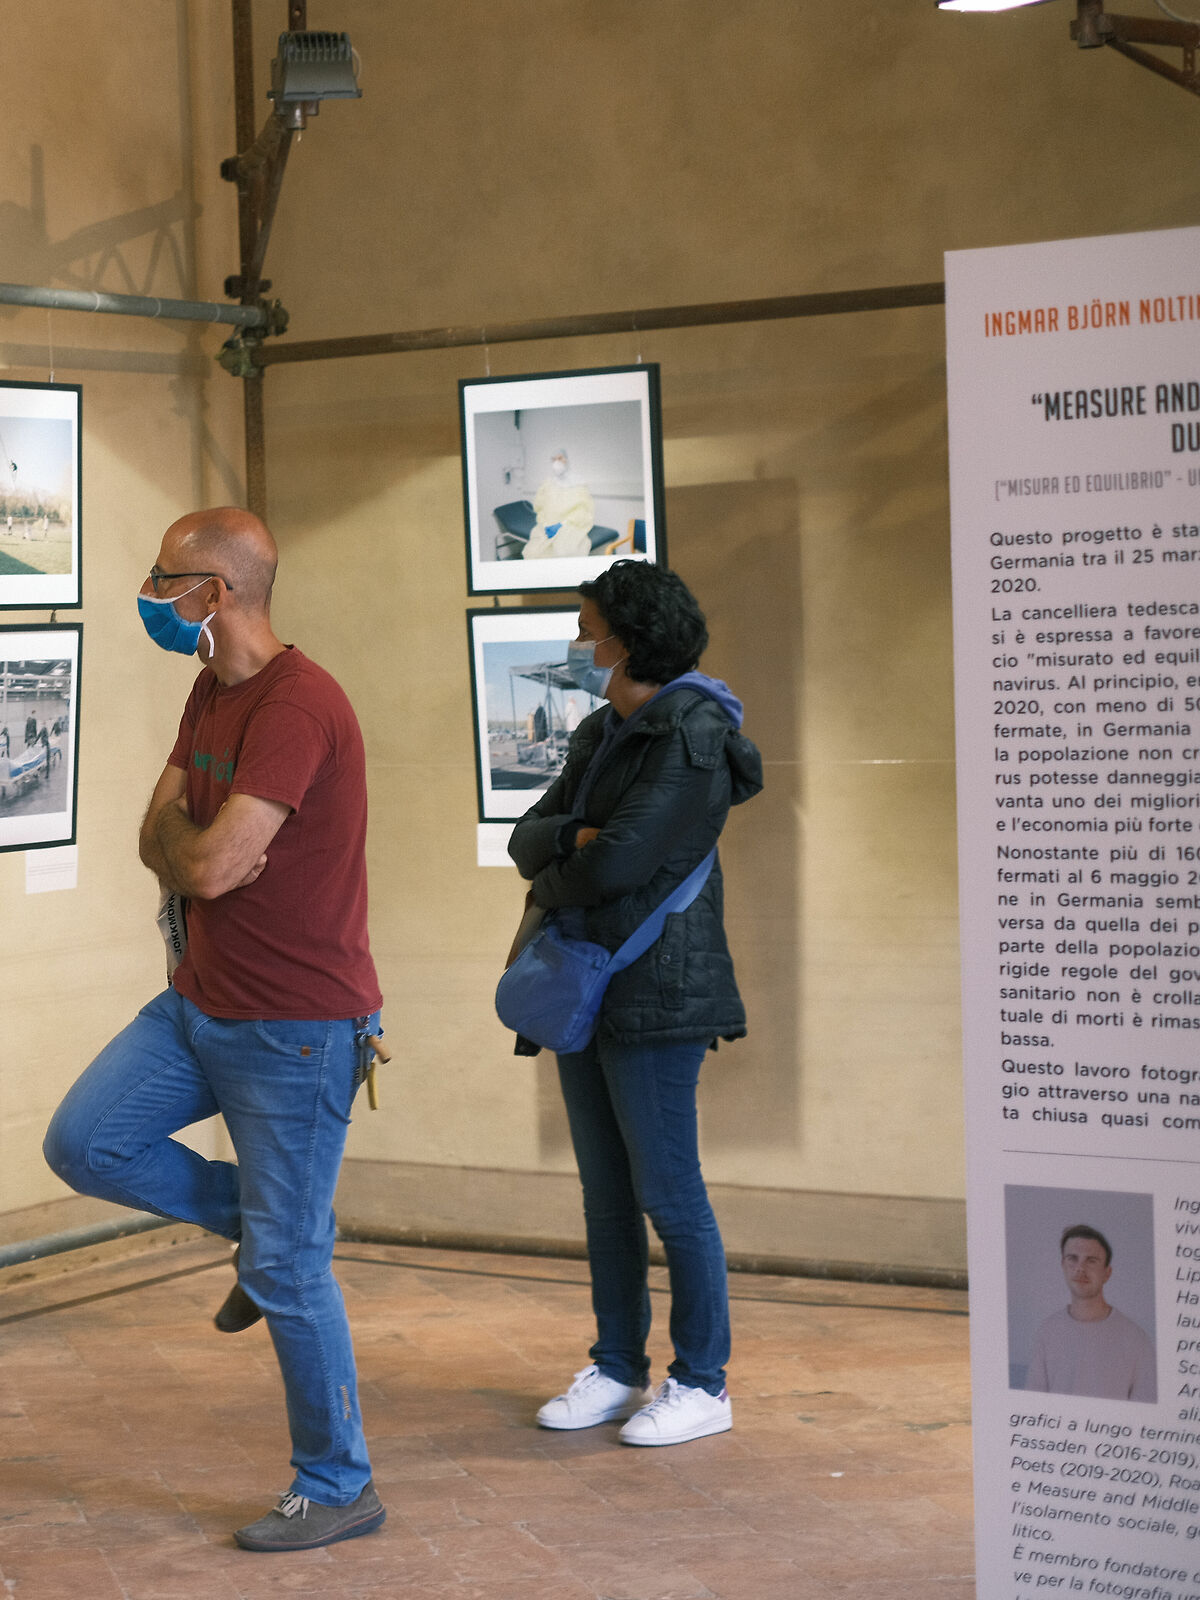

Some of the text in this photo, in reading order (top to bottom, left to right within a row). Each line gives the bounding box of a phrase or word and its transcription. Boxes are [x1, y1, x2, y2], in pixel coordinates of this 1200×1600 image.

[985, 307, 1059, 337] INGMAR
[1067, 299, 1130, 331] BJÖRN
[1155, 382, 1200, 414] AND
[1171, 423, 1200, 453] DU
[1064, 475, 1081, 494] ED
[990, 531, 1053, 547] Questo
[1062, 526, 1142, 546] progetto
[1152, 524, 1162, 539] è
[990, 549, 1200, 570] Germania tra il 25 mar
[991, 578, 1041, 593] 2020.
[992, 601, 1199, 621] La cancelliera tedesca
[992, 625, 1200, 645] si è espressa a favore
[992, 653, 1018, 668] cio
[1123, 649, 1145, 665] ed
[1155, 648, 1199, 666] equil
[993, 673, 1200, 692] navirus. Al principio, e
[994, 700, 1044, 716] 2020,
[1054, 702, 1086, 714] con
[1096, 701, 1147, 713] meno
[1157, 697, 1173, 712] di
[994, 721, 1191, 740] fermate, in Germania
[995, 746, 1200, 764] la popolazione non cr
[995, 769, 1200, 787] rus potesse danneggia
[995, 793, 1200, 811] vanta uno dei migliori
[996, 820, 1006, 831] e
[1012, 817, 1108, 832] l'economia
[1115, 817, 1142, 835] più
[1148, 817, 1193, 832] forte
[997, 845, 1099, 860] Nonostante
[1110, 845, 1138, 863] più
[1149, 846, 1165, 861] di
[997, 868, 1200, 888] fermati al 6 maggio 2
[998, 895, 1018, 906] ne
[1030, 892, 1045, 906] in
[1057, 892, 1143, 908] Germania
[998, 918, 1044, 930] versa
[1054, 916, 1075, 931] da
[1085, 917, 1140, 934] quella
[1150, 918, 1177, 933] dei
[999, 939, 1200, 959] parte della popolazio
[1000, 961, 1050, 979] rigide
[1061, 964, 1118, 981] regole
[1129, 965, 1157, 980] del
[1000, 985, 1200, 1005] sanitario non è crolla
[1000, 1009, 1200, 1029] tuale di morti è rimas
[1001, 1031, 1054, 1047] bassa.
[1001, 1059, 1200, 1084] Questo lavoro fotogr
[1002, 1082, 1200, 1106] gio attraverso una na
[1002, 1106, 1200, 1130] ta chiusa quasi com
[1174, 1197, 1200, 1215] Ing
[1175, 1221, 1200, 1235] viv
[1176, 1267, 1200, 1284] Lip
[1176, 1290, 1199, 1305] Ha
[1177, 1313, 1200, 1329] lau
[1178, 1359, 1200, 1375] Sc
[1177, 1383, 1200, 1398] Ar
[1178, 1407, 1200, 1422] ali
[1010, 1413, 1062, 1429] grafici
[1067, 1420, 1078, 1431] a
[1085, 1419, 1132, 1439] lungo
[1010, 1433, 1087, 1455] Fassaden
[1011, 1456, 1200, 1491] Poets (2019-2020), Roa
[1011, 1481, 1199, 1514] e Measure and Middle
[1011, 1501, 1111, 1528] l'isolamento
[1117, 1517, 1179, 1537] sociale,
[1012, 1523, 1054, 1541] litico.
[1013, 1543, 1024, 1560] È
[1028, 1551, 1099, 1570] membro
[1104, 1557, 1188, 1582] fondatore
[1014, 1571, 1032, 1583] ve
[1036, 1575, 1065, 1587] per
[1069, 1576, 1084, 1591] la
[1089, 1578, 1172, 1600] fotografia
